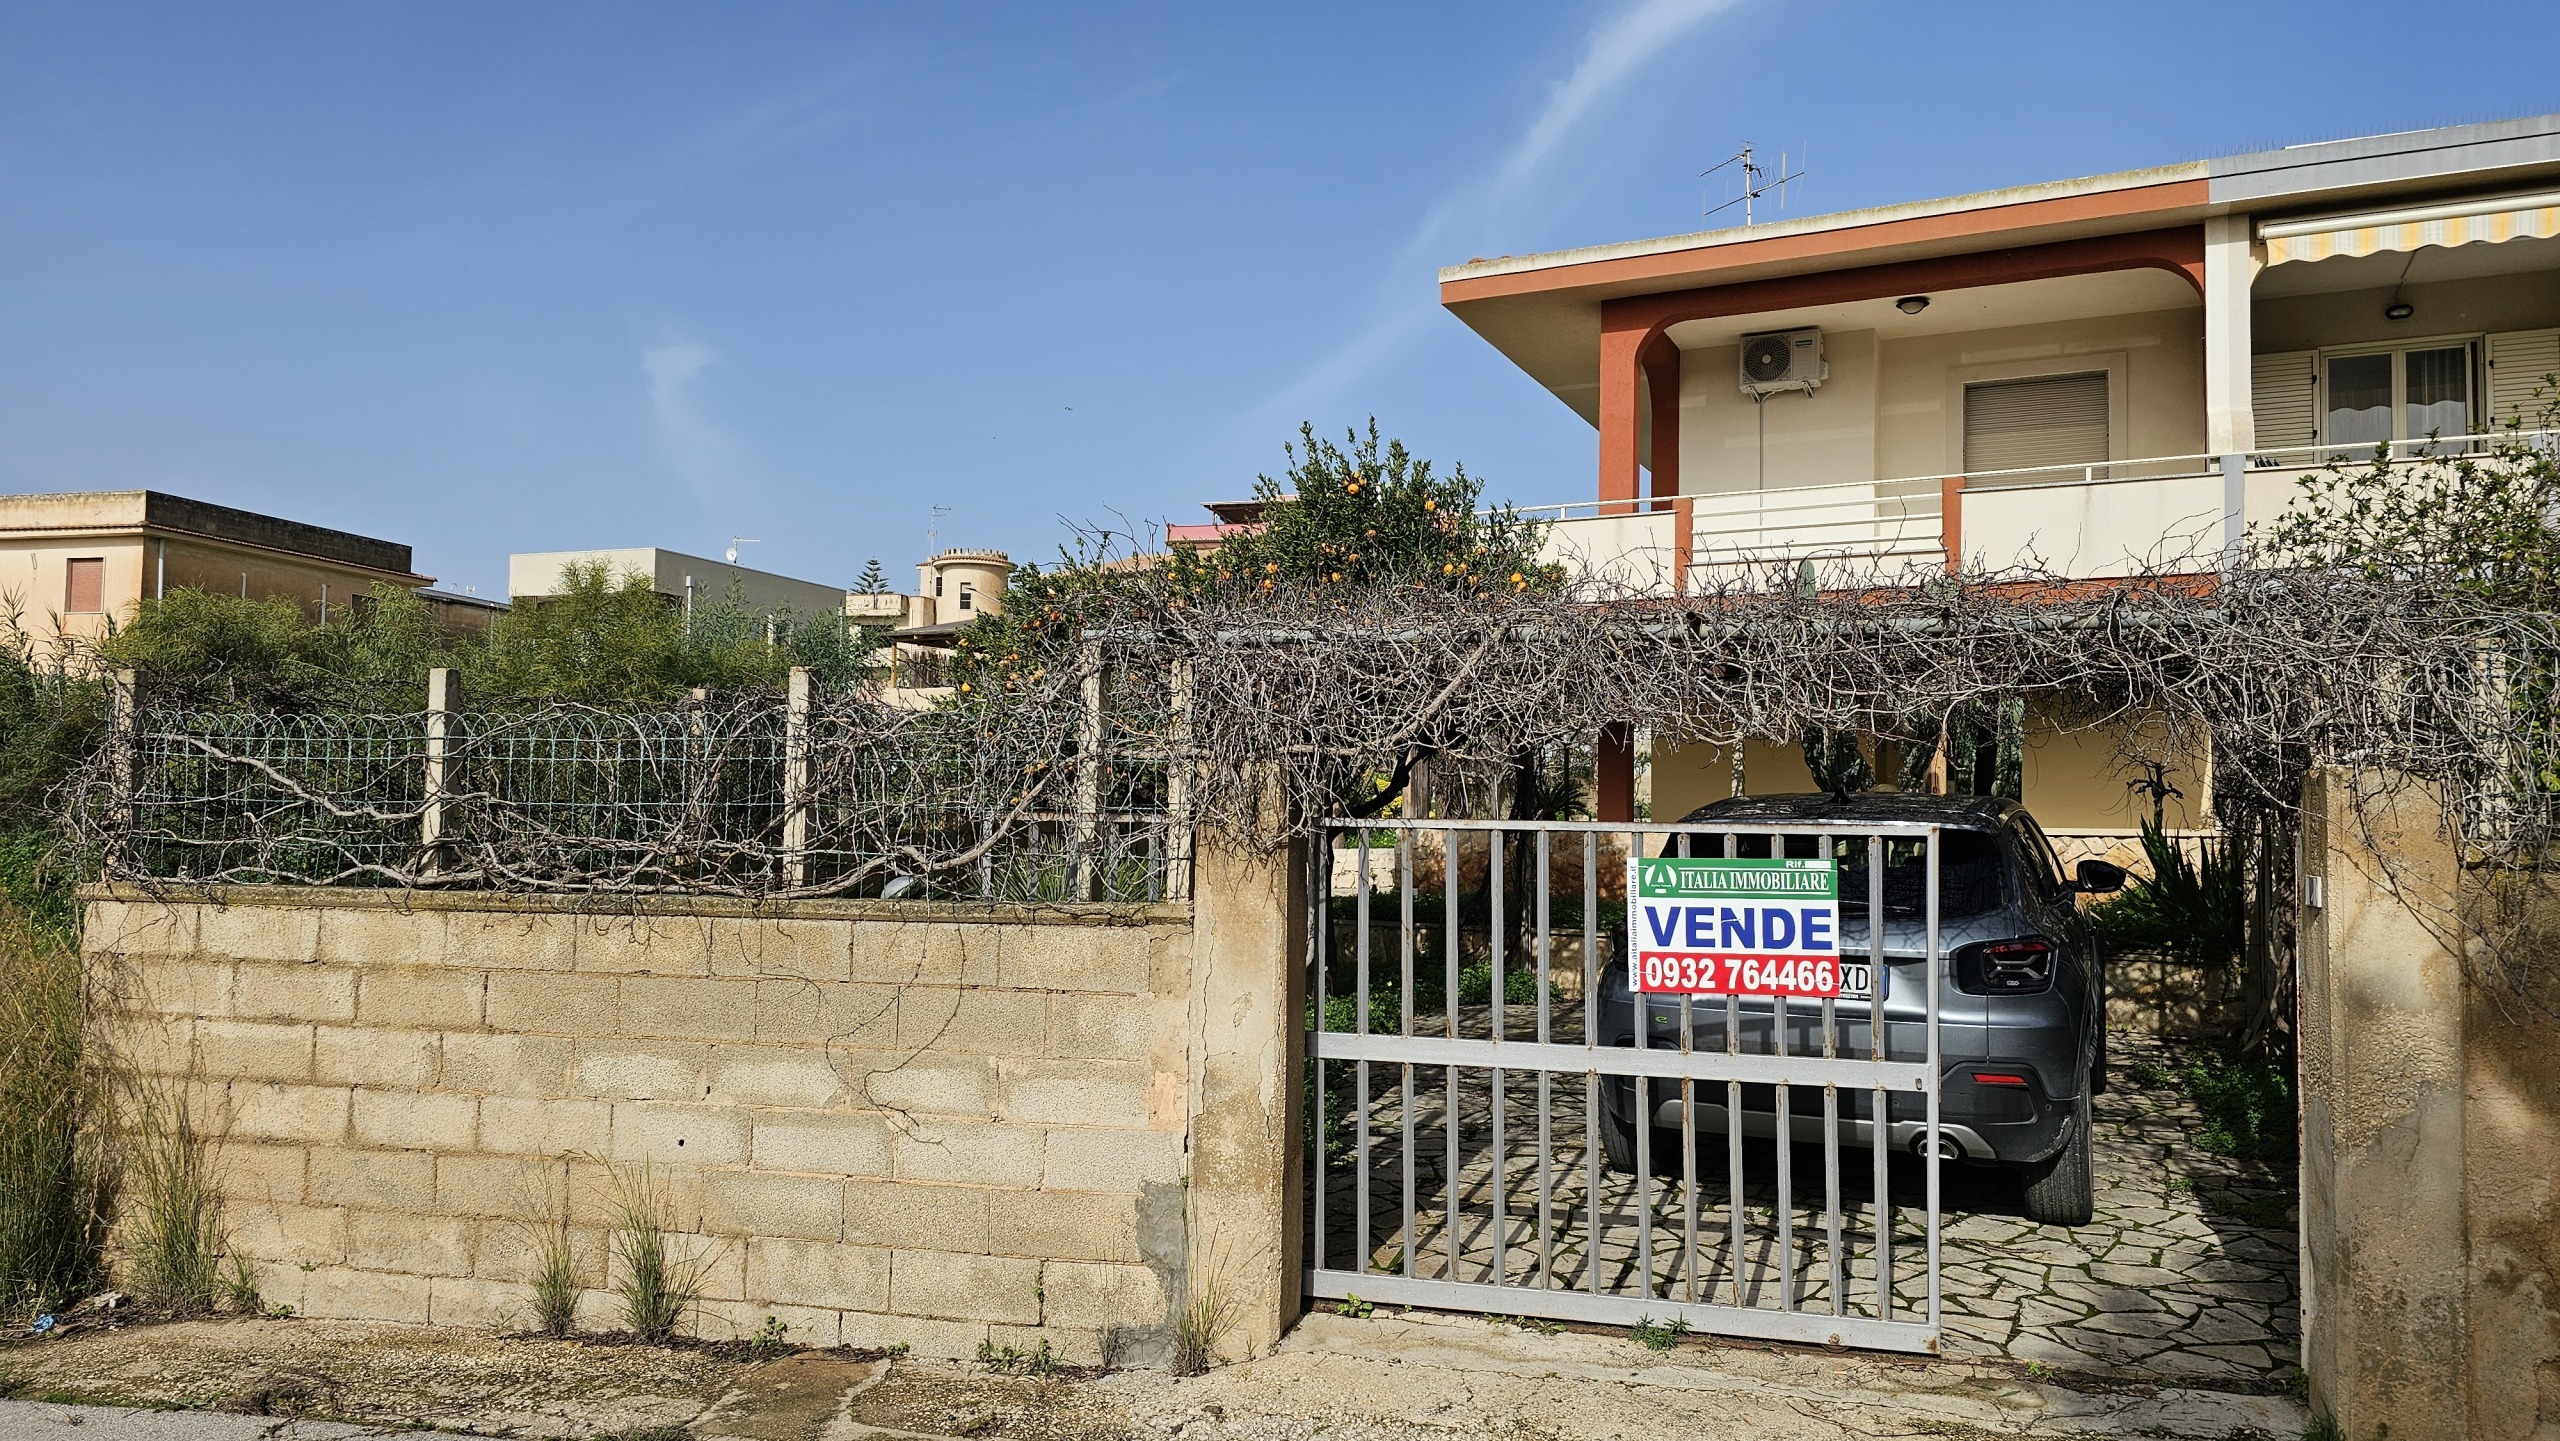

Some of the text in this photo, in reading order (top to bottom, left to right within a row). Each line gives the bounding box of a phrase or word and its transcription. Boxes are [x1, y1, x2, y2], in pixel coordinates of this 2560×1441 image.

[1786, 860, 1805, 869] Rif.
[1680, 871, 1729, 890] ITALIA
[1730, 872, 1830, 891] IMMOBILIARE
[1630, 865, 1638, 987] www.aitaliaimmobiliare.it
[1644, 906, 1833, 950] VENDE
[1645, 956, 1834, 992] 0932 764466
[1840, 966, 1869, 991] XD
